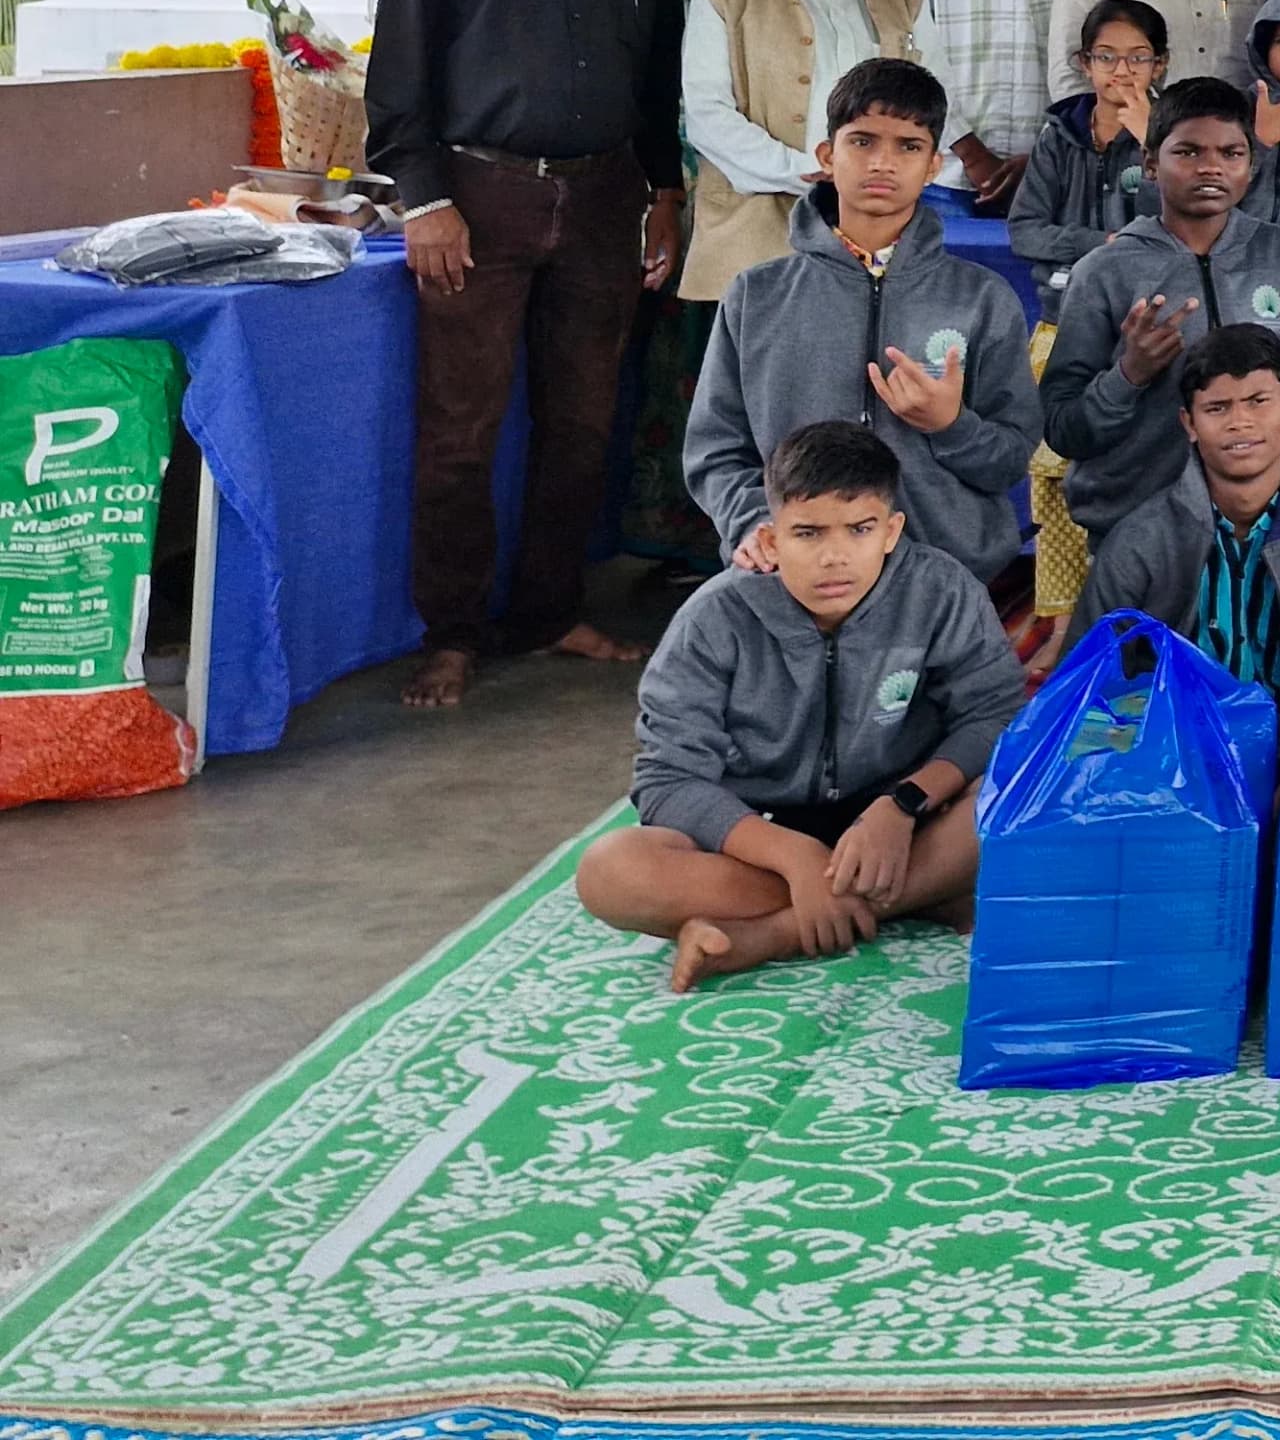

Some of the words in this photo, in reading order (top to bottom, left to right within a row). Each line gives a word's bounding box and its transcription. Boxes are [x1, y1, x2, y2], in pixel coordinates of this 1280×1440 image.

[0, 485, 99, 520] RATHAM
[104, 483, 161, 504] GOL
[11, 511, 96, 534] Masoor
[102, 506, 145, 524] Dal
[121, 533, 147, 544] LTD.
[20, 601, 45, 613] Net
